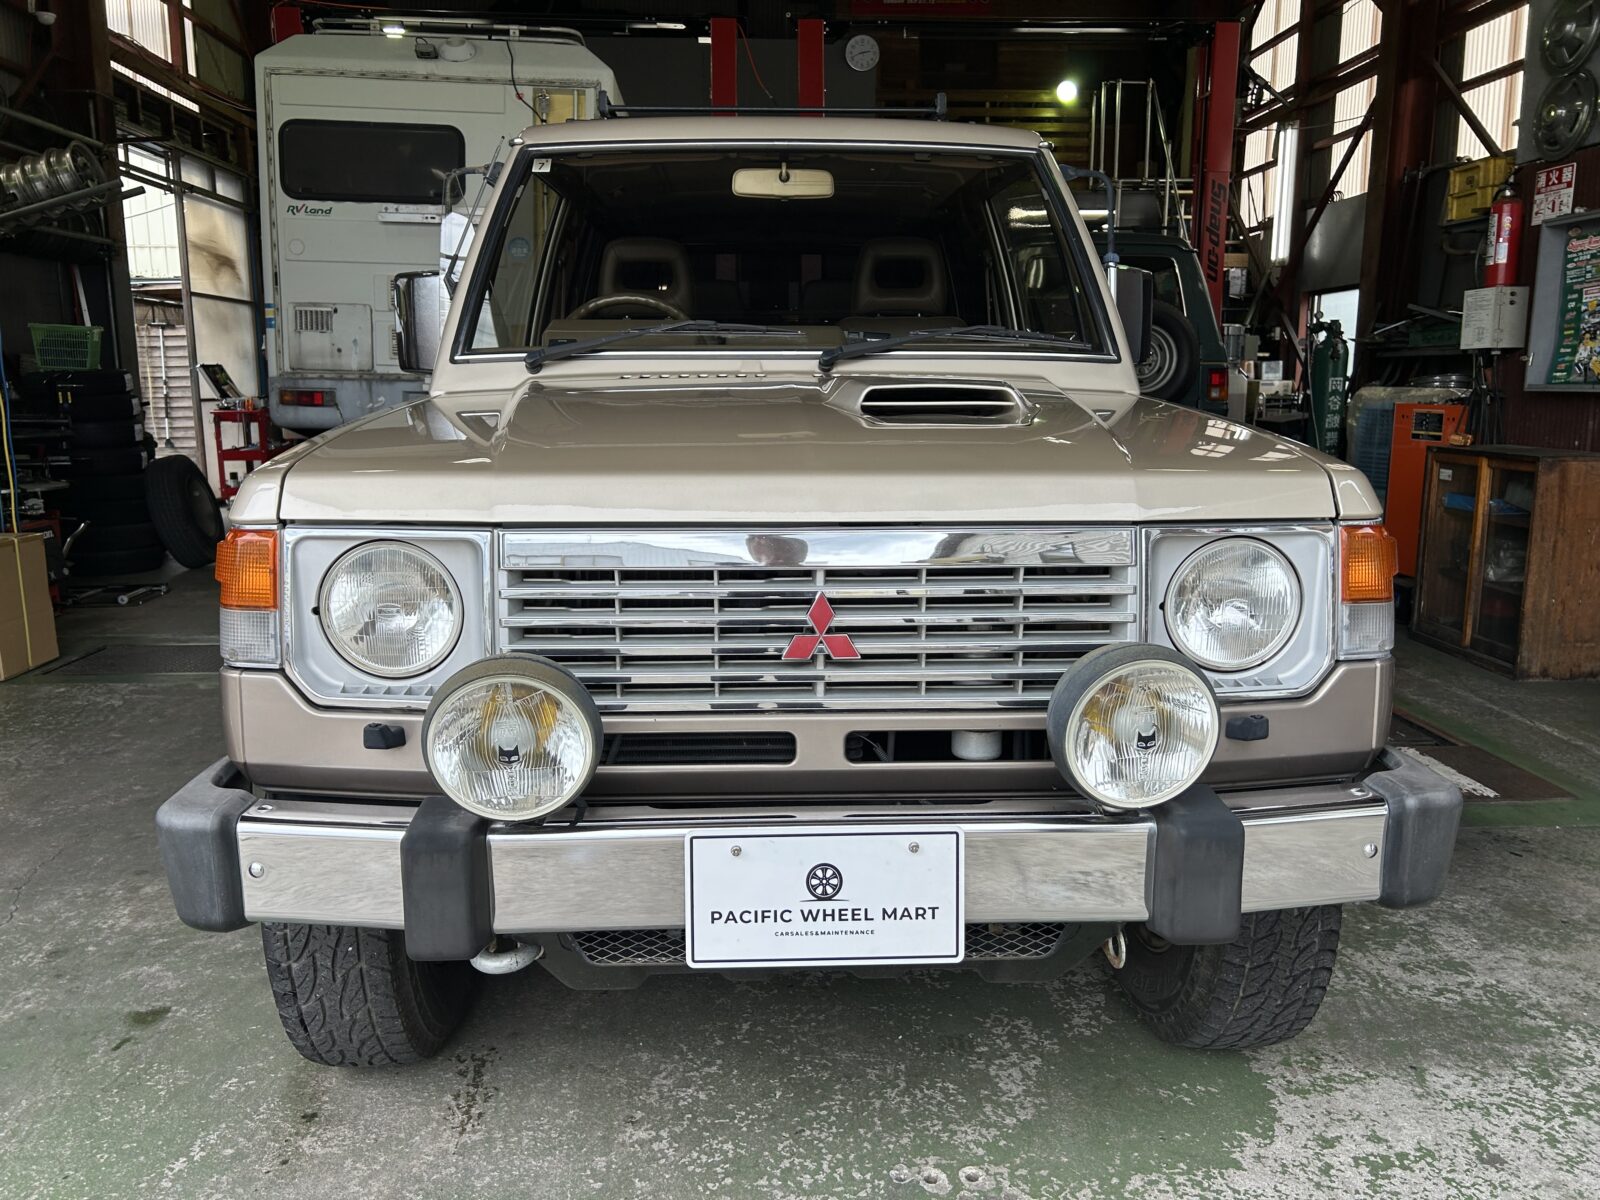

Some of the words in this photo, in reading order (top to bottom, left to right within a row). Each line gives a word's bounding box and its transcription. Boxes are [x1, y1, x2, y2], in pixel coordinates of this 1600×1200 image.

[538, 162, 545, 170] 7
[1535, 166, 1573, 188] 消火器
[710, 909, 793, 924] PACIFIC
[800, 908, 874, 922] WHEEL
[881, 906, 940, 921] MART
[774, 929, 875, 937] CARSALES&MAINTENANCE
